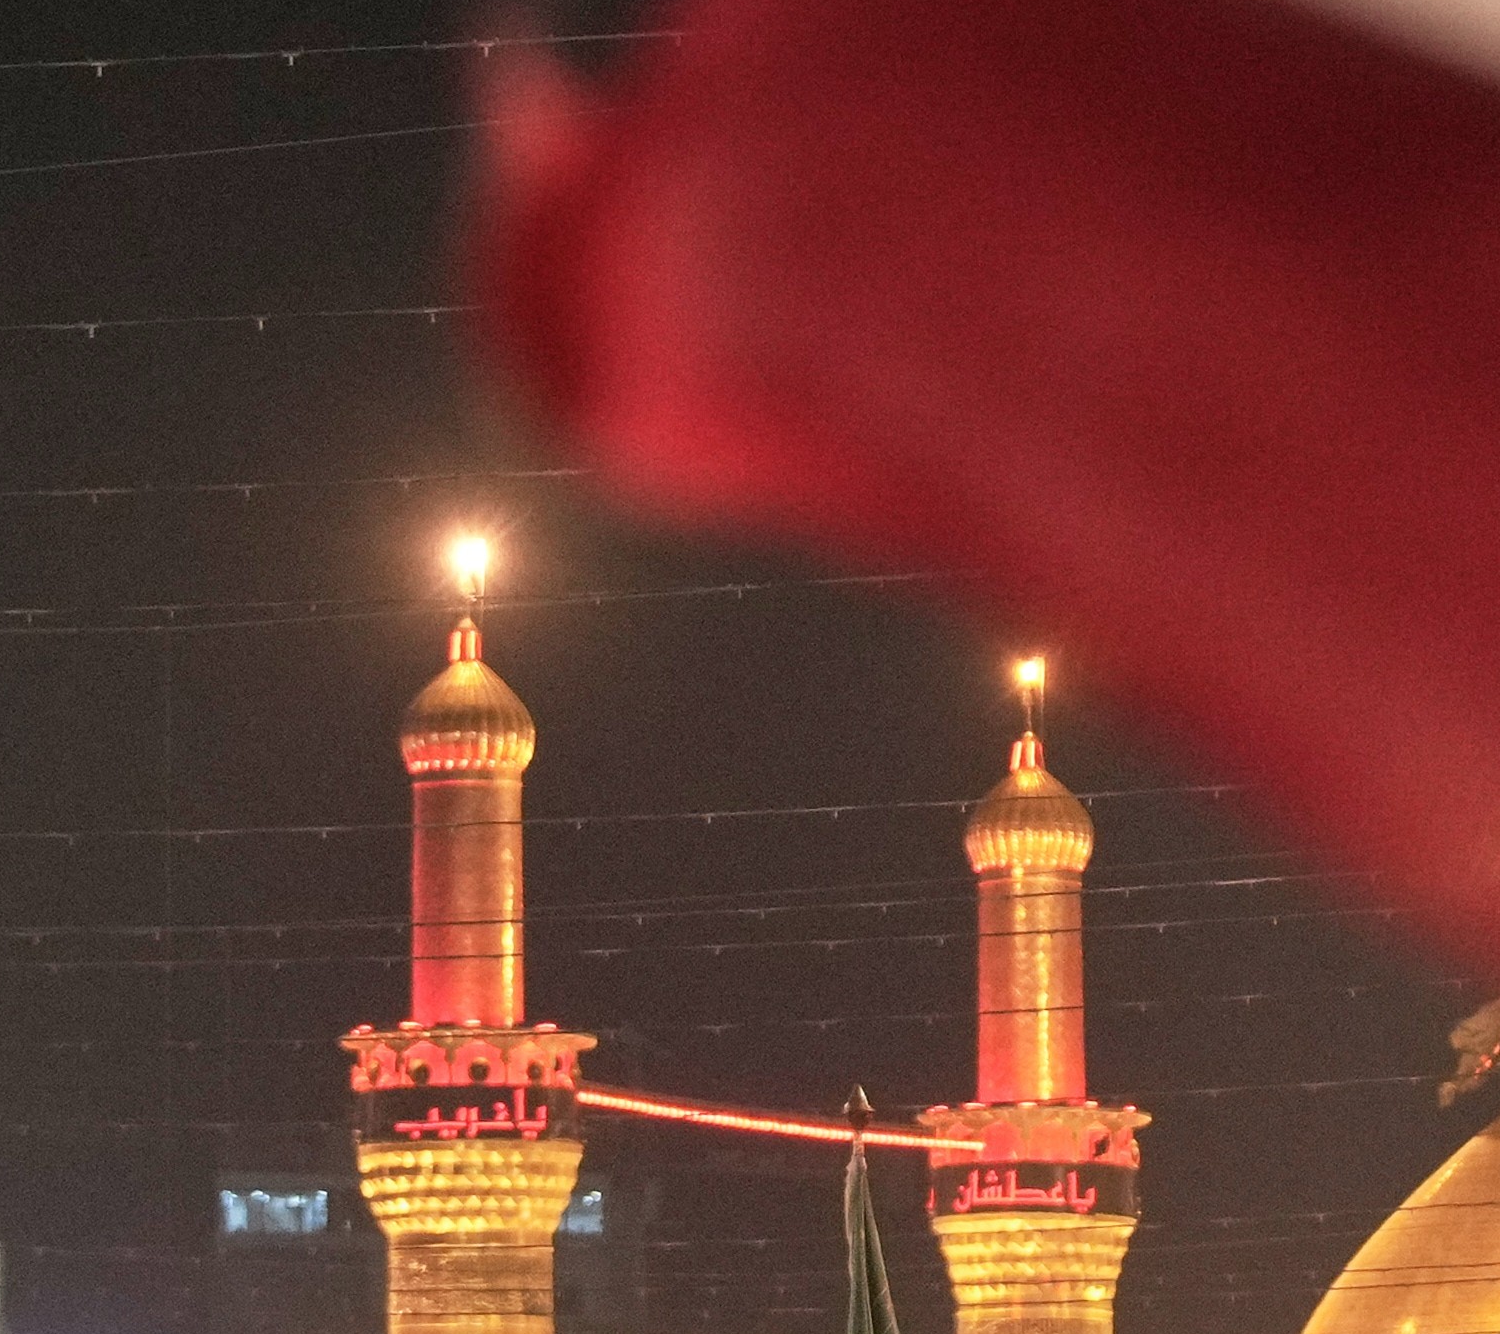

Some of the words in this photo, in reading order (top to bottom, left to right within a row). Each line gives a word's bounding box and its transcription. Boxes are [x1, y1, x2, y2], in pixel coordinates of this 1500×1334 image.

[514, 1086, 548, 1141] يا
[952, 1169, 1067, 1214] عطشان
[1067, 1170, 1098, 1215] يا
